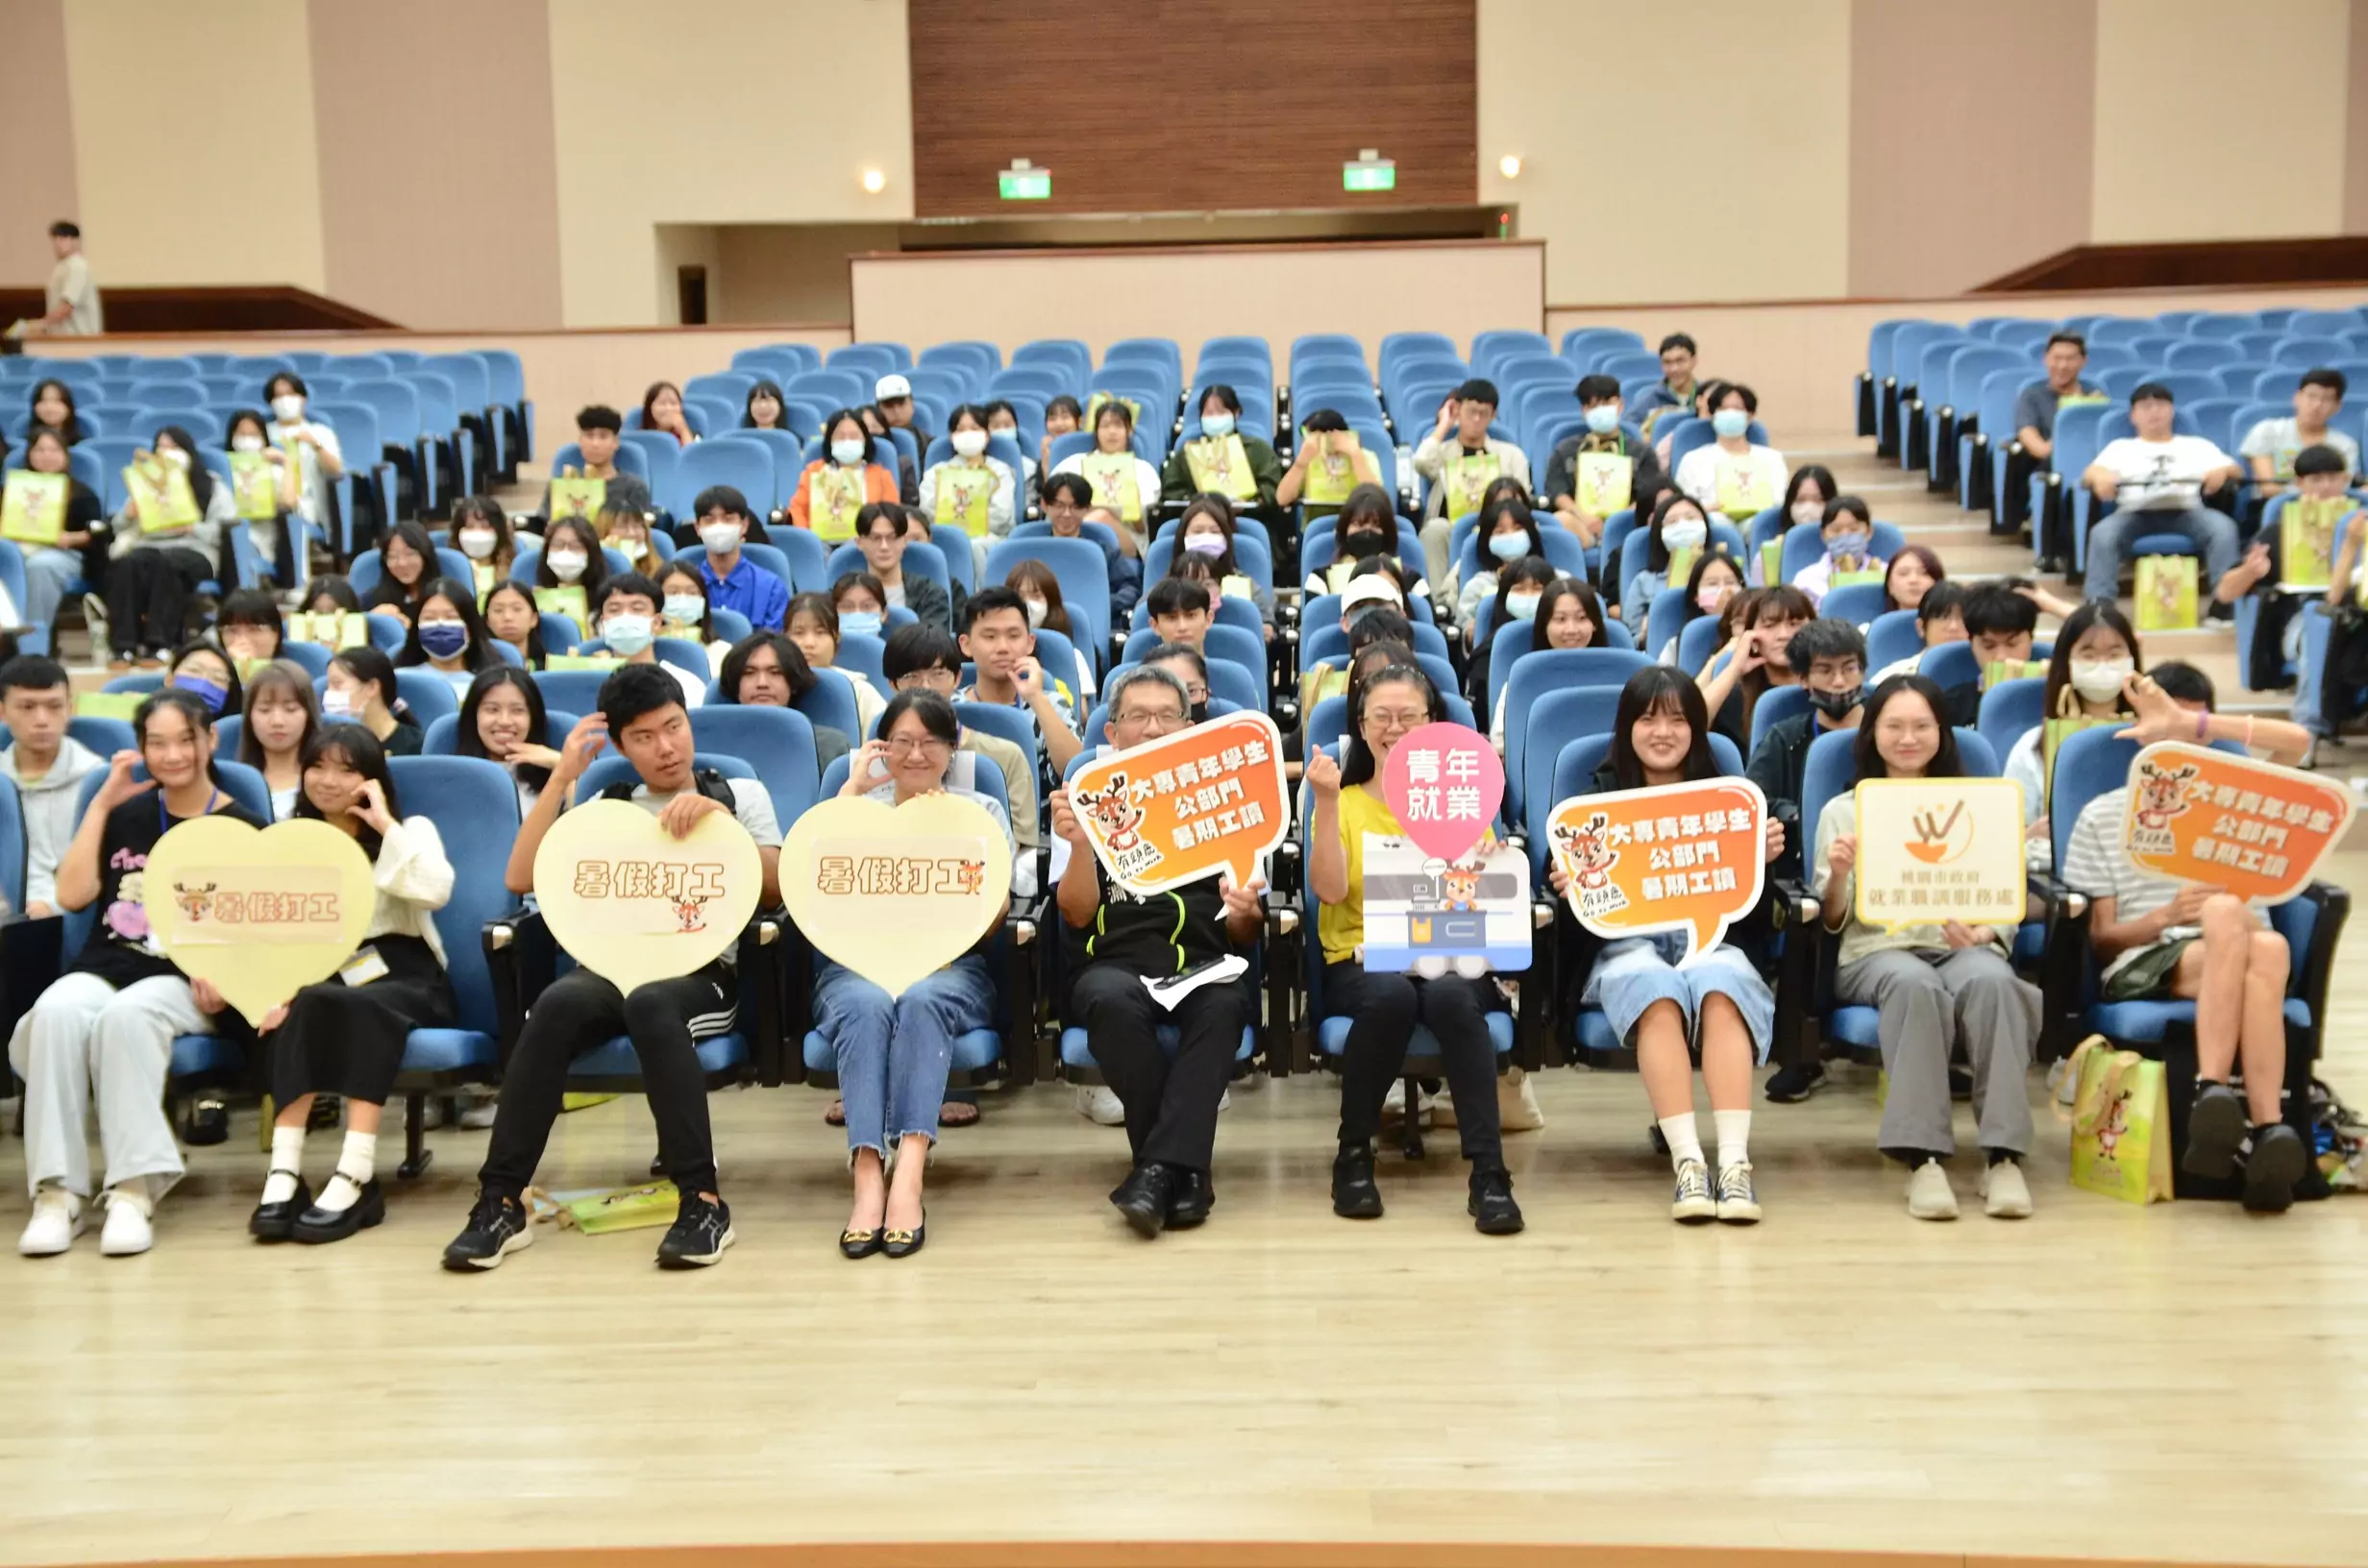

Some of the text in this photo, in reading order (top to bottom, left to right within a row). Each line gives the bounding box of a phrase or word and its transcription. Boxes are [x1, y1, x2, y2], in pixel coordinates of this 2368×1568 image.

[1129, 740, 1270, 803] 大專青年學生
[1406, 748, 1480, 783] 青年
[1174, 777, 1246, 820] 公部門
[1406, 786, 1481, 821] 就業
[1172, 801, 1266, 851] 暑期工讀
[1609, 808, 1753, 846] 大專青年學生
[2212, 814, 2289, 849] 公部門
[1649, 840, 1720, 870] 公部門
[574, 860, 726, 898] 暑假打工
[817, 857, 970, 895] 暑假打工
[1641, 867, 1737, 900] 暑期工讀
[214, 893, 339, 923] 暑假打工
